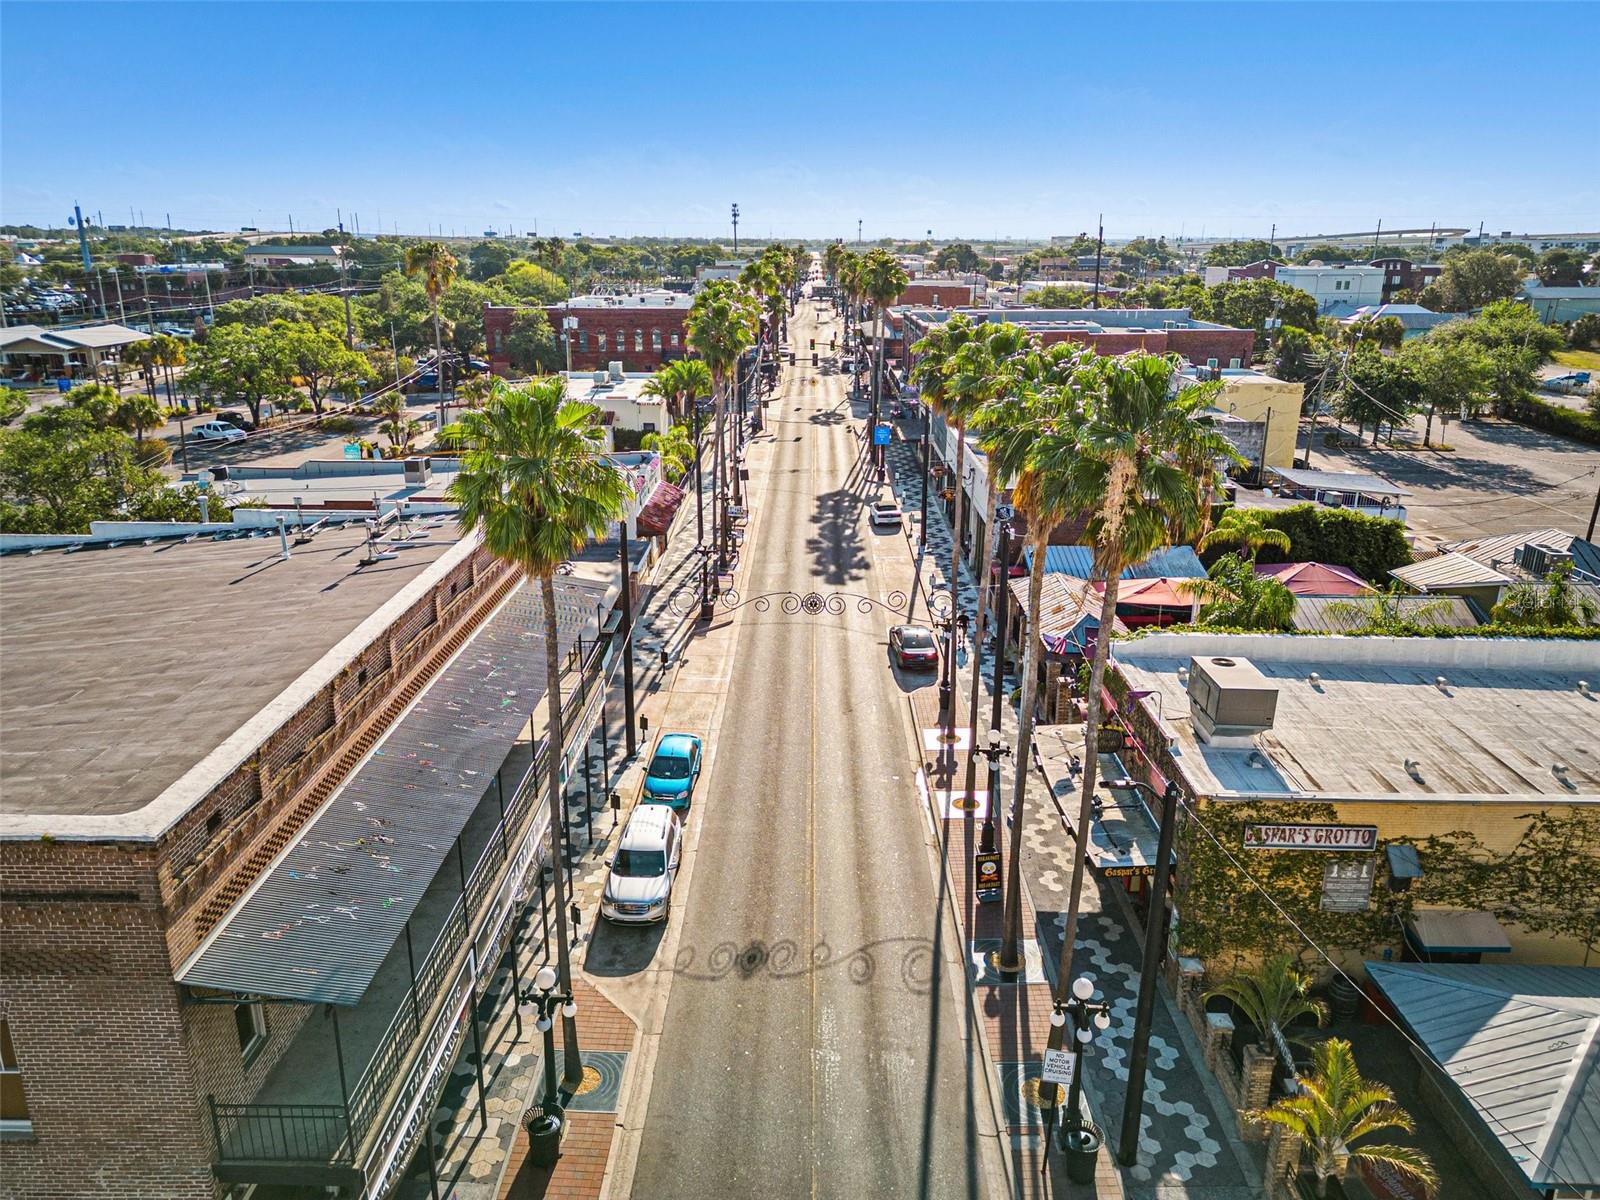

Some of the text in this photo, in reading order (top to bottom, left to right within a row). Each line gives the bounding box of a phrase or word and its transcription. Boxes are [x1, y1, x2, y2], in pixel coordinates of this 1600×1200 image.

[1314, 829, 1372, 844] GROTTO
[1104, 867, 1140, 877] Gaspar's
[382, 1097, 407, 1159] ENJOY
[409, 1063, 424, 1098] THE
[426, 985, 461, 1064] AUTHENTIC
[1044, 1068, 1072, 1076] CRUISING
[1046, 1063, 1071, 1071] VEHICLE
[389, 1104, 423, 1180] BAKED
